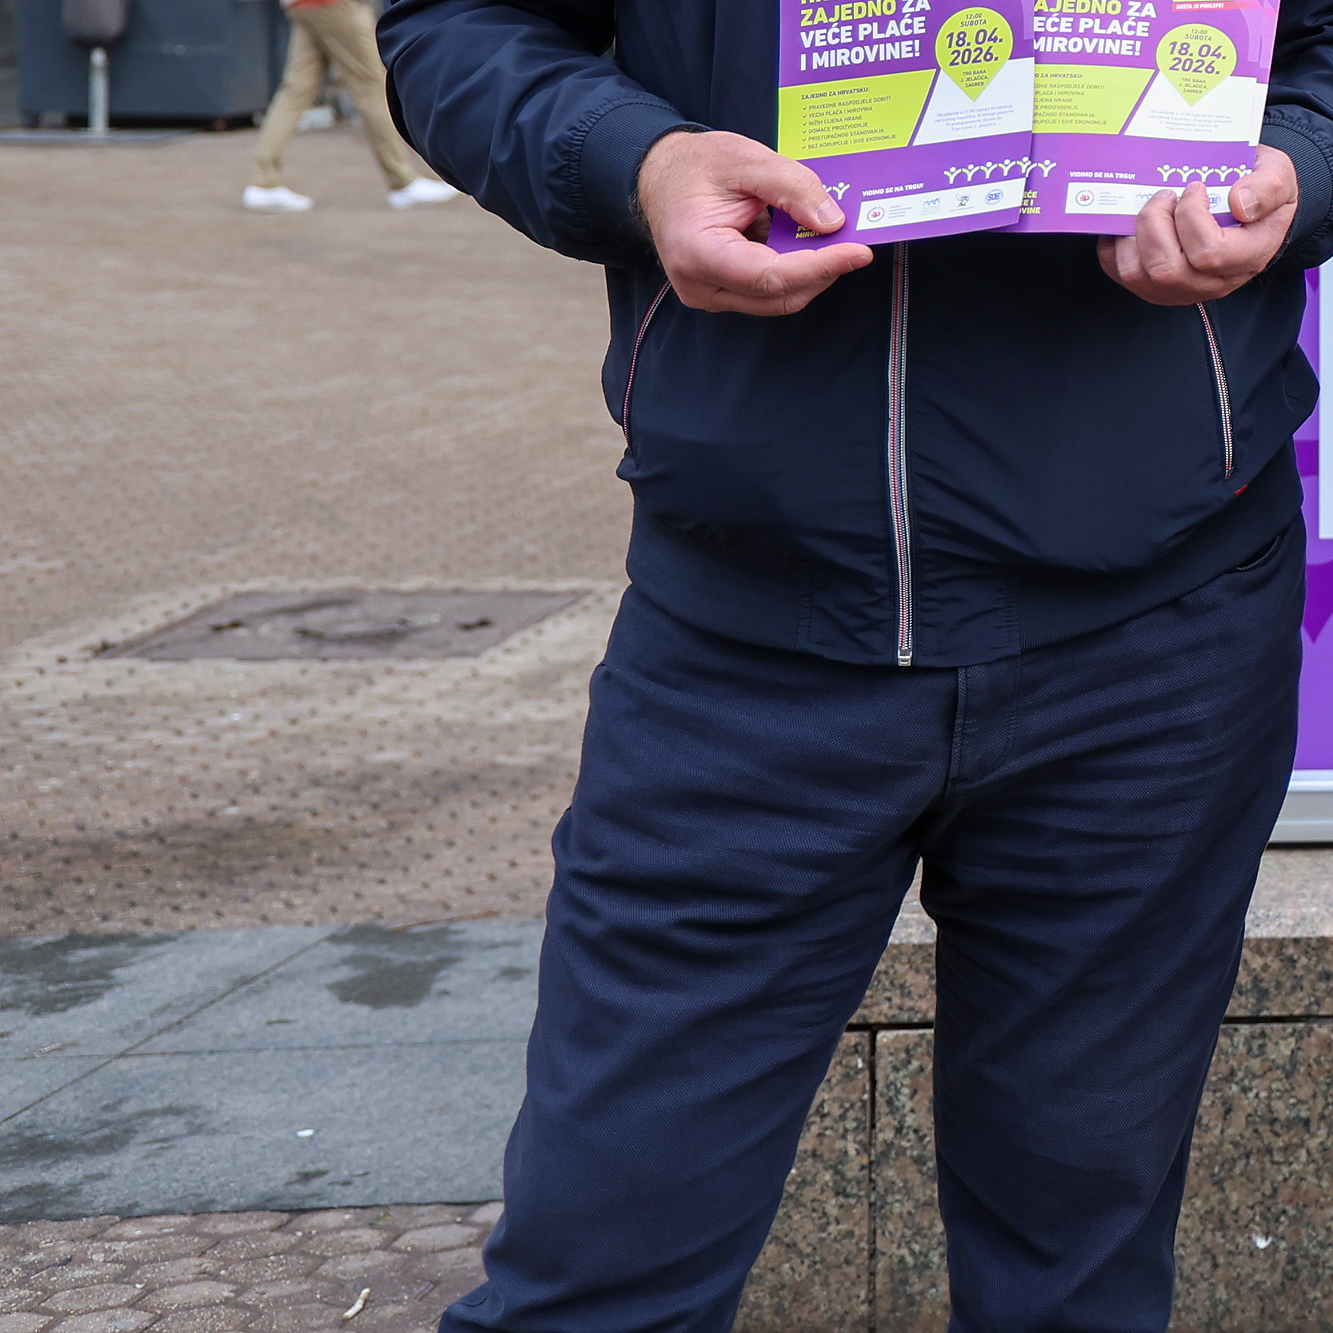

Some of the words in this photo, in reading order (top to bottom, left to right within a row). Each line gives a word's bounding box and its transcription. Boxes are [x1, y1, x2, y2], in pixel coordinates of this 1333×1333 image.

[1127, 2, 1158, 18] ZA
[800, 21, 853, 48] VEĆE
[859, 12, 925, 41] PLAĆE
[960, 19, 987, 27] SUBOTA
[1033, 12, 1074, 32] EĆE
[1078, 14, 1150, 37] PLAĆE
[946, 31, 971, 49] 18.
[975, 27, 1003, 45] 04.
[801, 54, 806, 71] I
[812, 40, 919, 69] MIROVINE!
[949, 45, 999, 66] 2026.
[1168, 41, 1195, 57] 18.
[1198, 44, 1228, 60] 04.
[1169, 57, 1221, 75] 2026.
[801, 92, 828, 100] ZAJEDNO
[837, 87, 870, 96] HRVATSKU:
[904, 183, 924, 191] TRGU!
